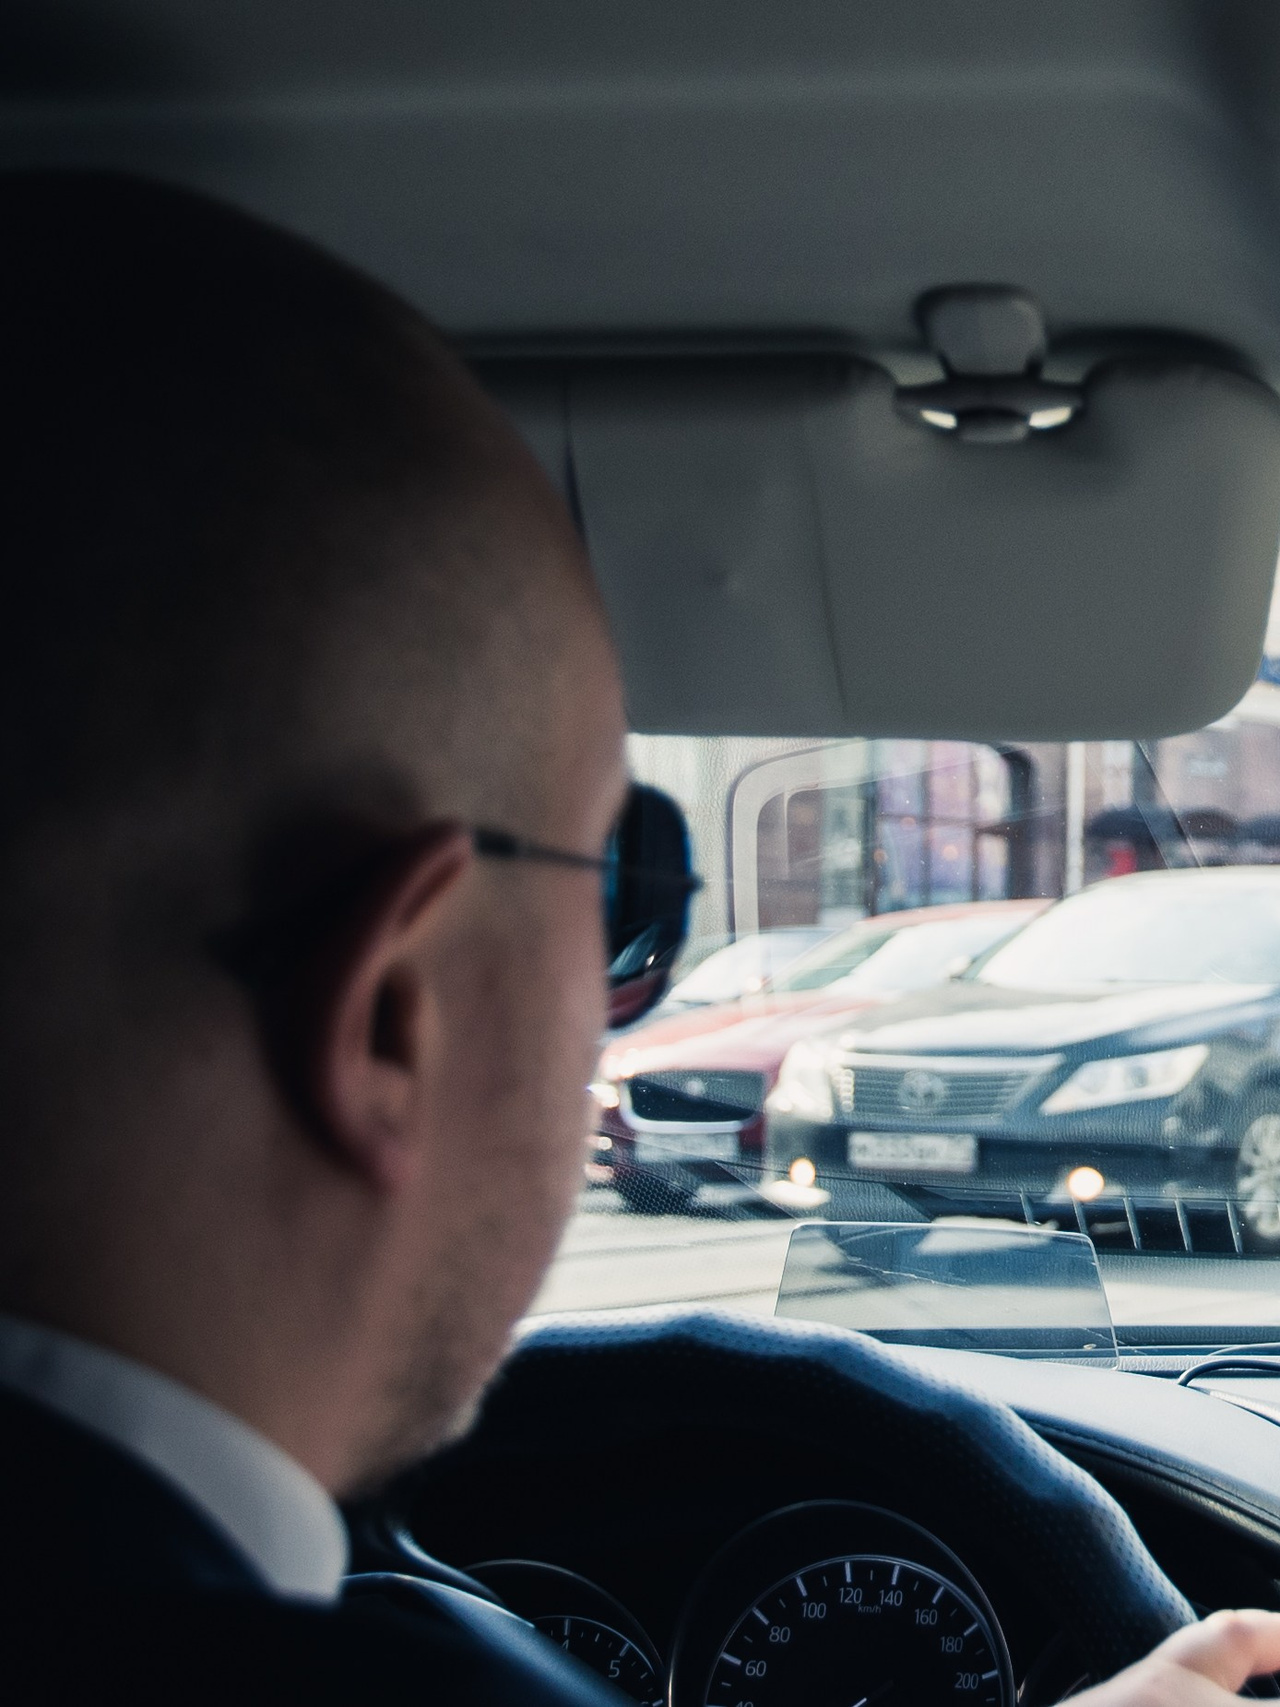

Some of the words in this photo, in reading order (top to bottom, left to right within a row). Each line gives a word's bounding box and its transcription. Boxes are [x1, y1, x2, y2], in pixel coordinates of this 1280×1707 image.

[838, 1587, 863, 1604] 120
[879, 1589, 903, 1606] 140
[802, 1602, 827, 1619] 100
[857, 1603, 882, 1614] km/h
[914, 1609, 938, 1625] 160
[768, 1626, 791, 1643] 80
[939, 1636, 963, 1653] 180
[608, 1660, 621, 1678] 5
[744, 1660, 767, 1677] 60
[955, 1672, 979, 1689] 200
